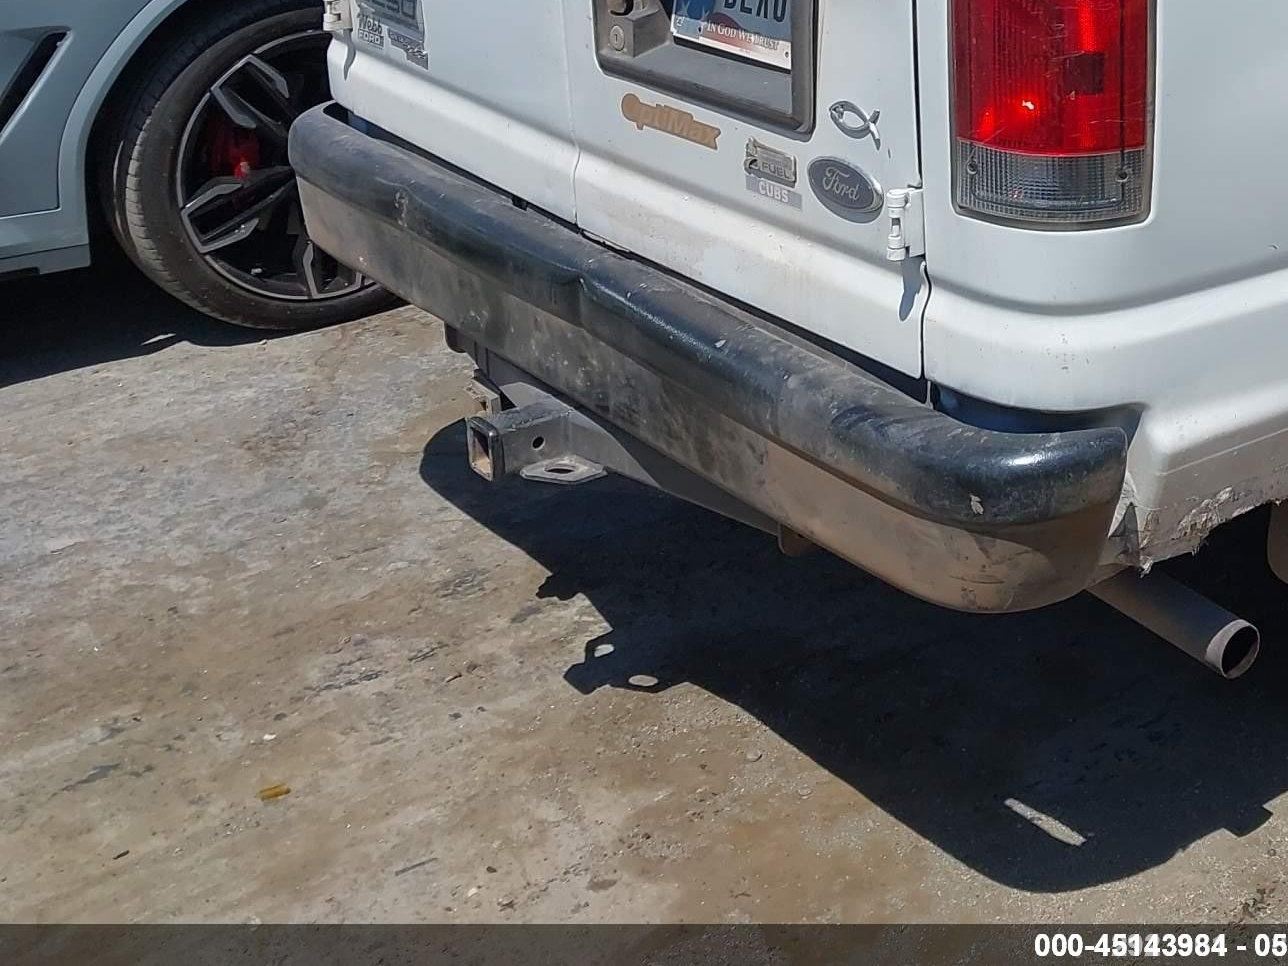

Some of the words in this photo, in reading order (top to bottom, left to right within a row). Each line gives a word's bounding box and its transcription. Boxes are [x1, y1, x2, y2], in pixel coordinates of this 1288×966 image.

[359, 30, 382, 45] FORD
[717, 21, 738, 38] GOD
[752, 33, 780, 51] TRUST
[758, 181, 789, 203] CUBS
[822, 165, 861, 202] Ford
